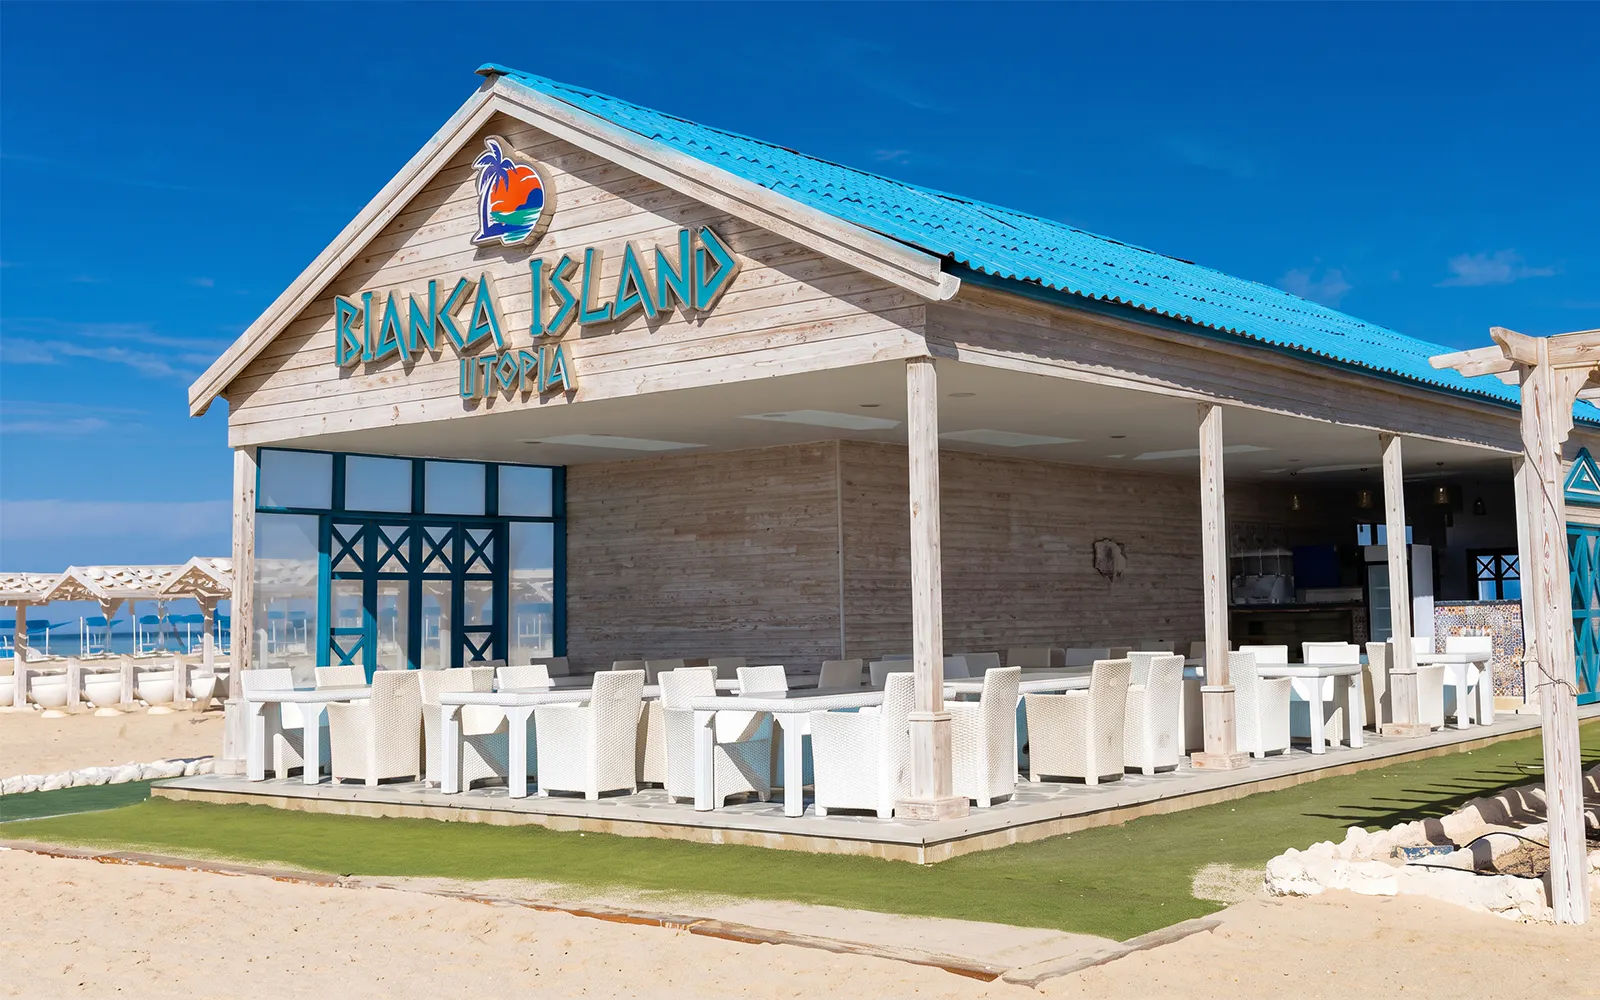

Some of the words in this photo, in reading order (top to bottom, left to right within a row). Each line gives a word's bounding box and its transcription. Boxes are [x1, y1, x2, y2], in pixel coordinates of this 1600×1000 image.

[334, 271, 510, 368] BIANCA
[529, 225, 741, 337] ISLAND
[459, 343, 576, 400] UTOPIA
